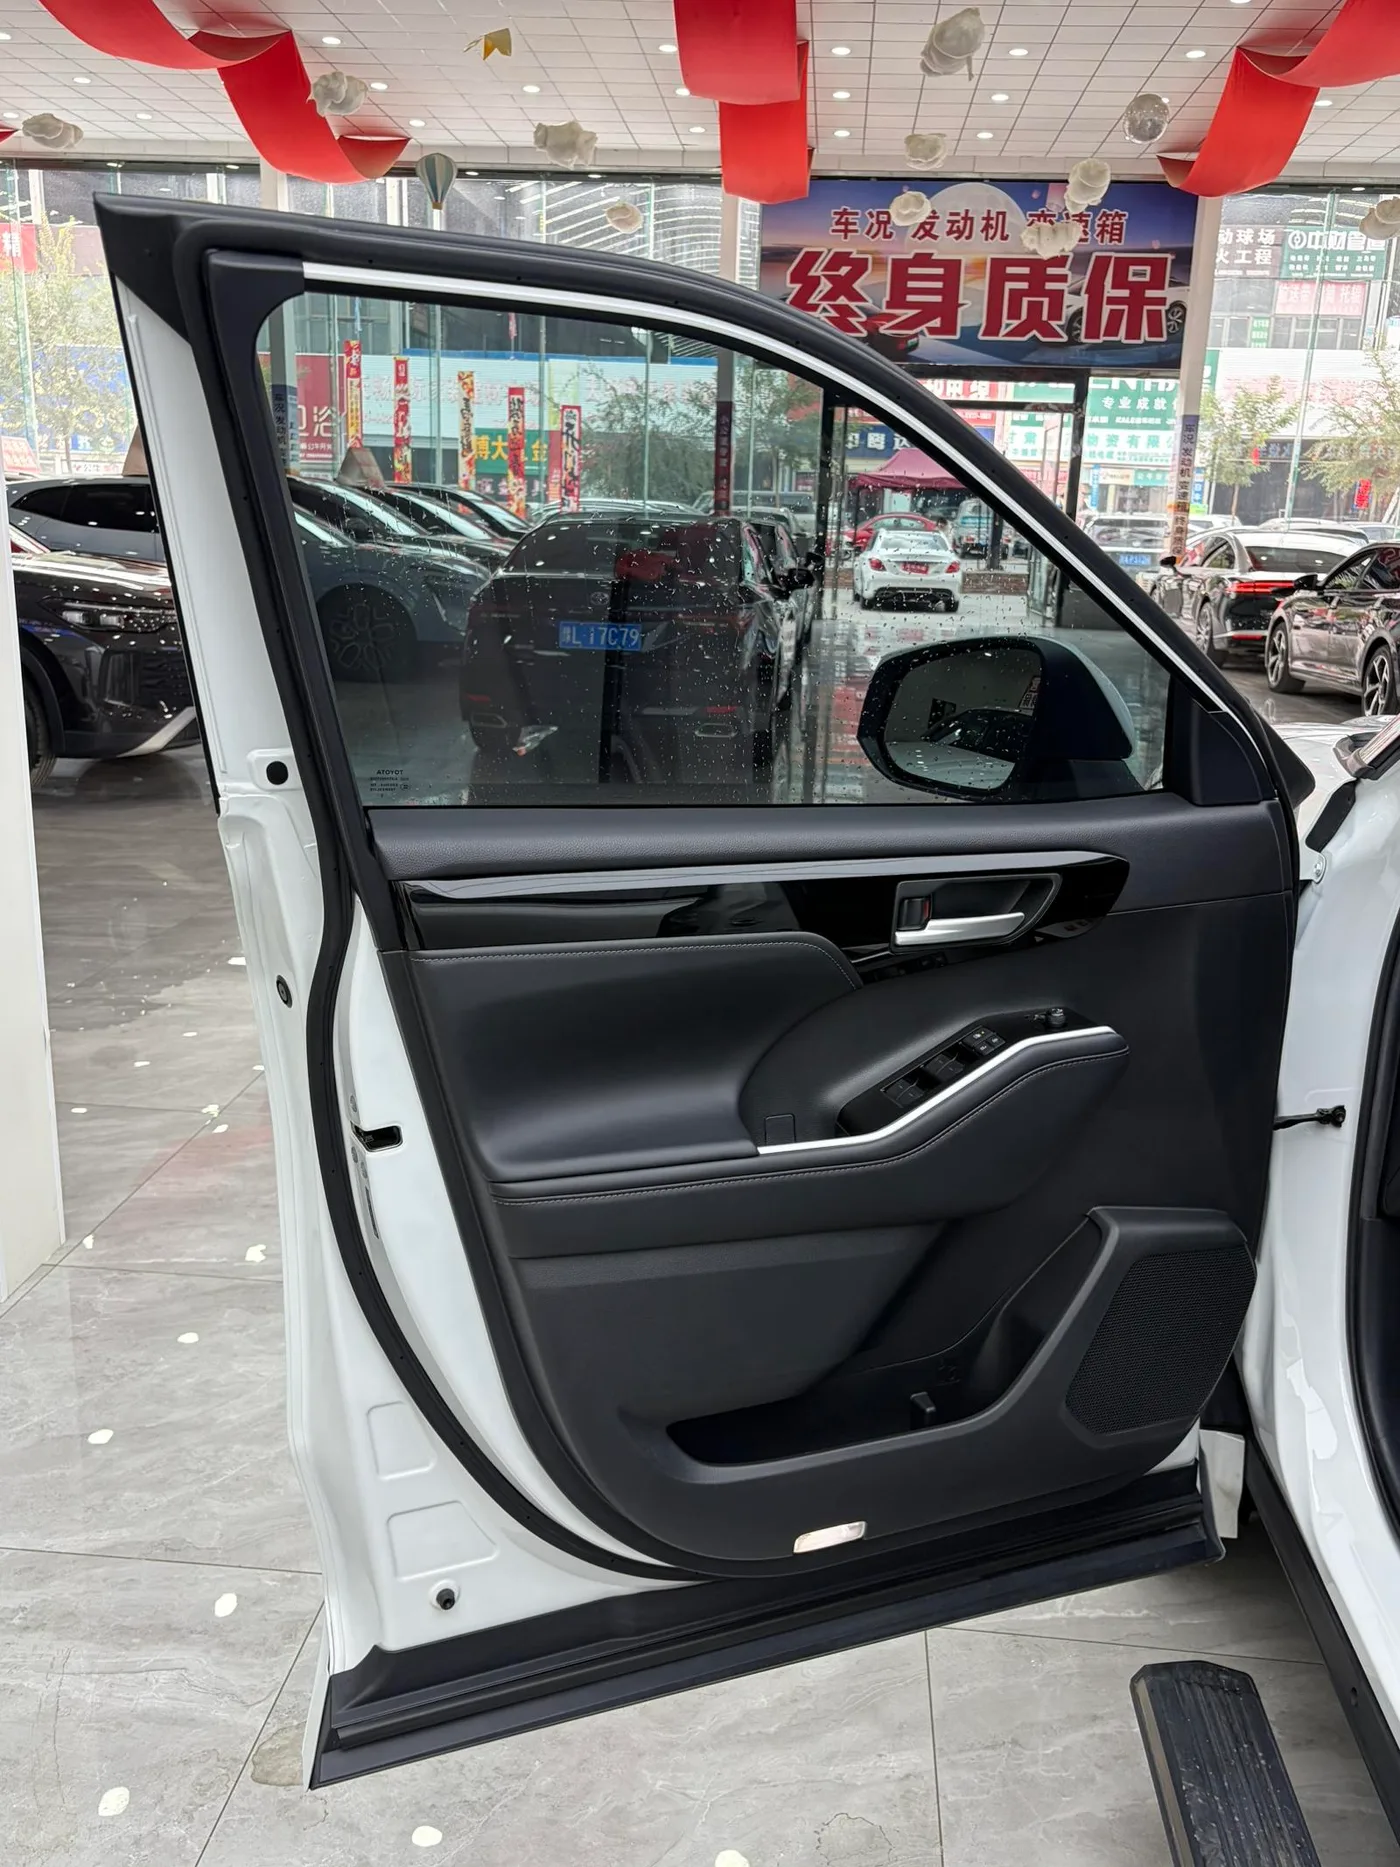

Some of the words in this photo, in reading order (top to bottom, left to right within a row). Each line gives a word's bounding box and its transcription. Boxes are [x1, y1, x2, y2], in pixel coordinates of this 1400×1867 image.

[830, 207, 893, 241] 车况
[912, 209, 1010, 243] 发动机
[787, 248, 1176, 343] 终身质保
[472, 435, 548, 462] 博大金
